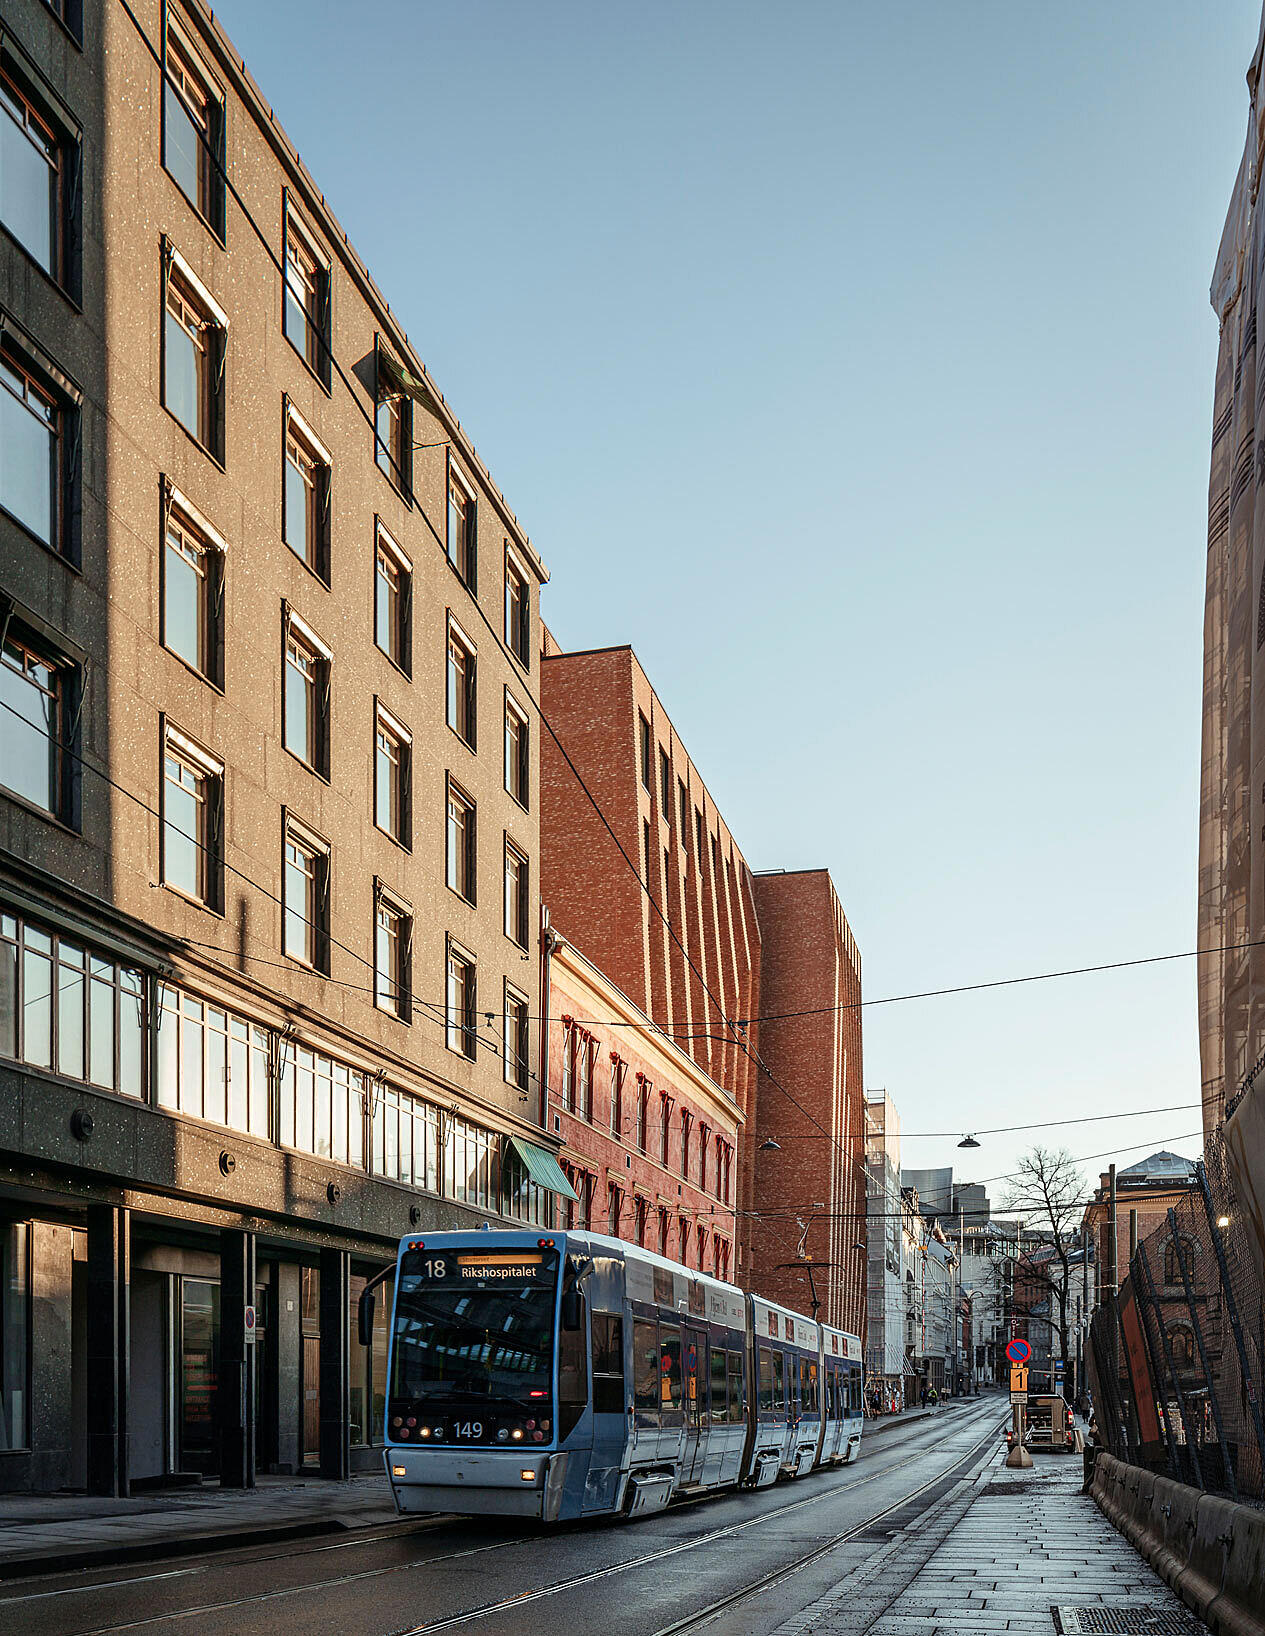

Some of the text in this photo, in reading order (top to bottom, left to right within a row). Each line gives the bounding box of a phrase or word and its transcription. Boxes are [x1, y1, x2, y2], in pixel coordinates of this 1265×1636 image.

[424, 1259, 446, 1278] 18
[461, 1265, 537, 1280] Rikshospitalet
[1015, 1371, 1023, 1389] 1
[453, 1421, 483, 1438] 149
